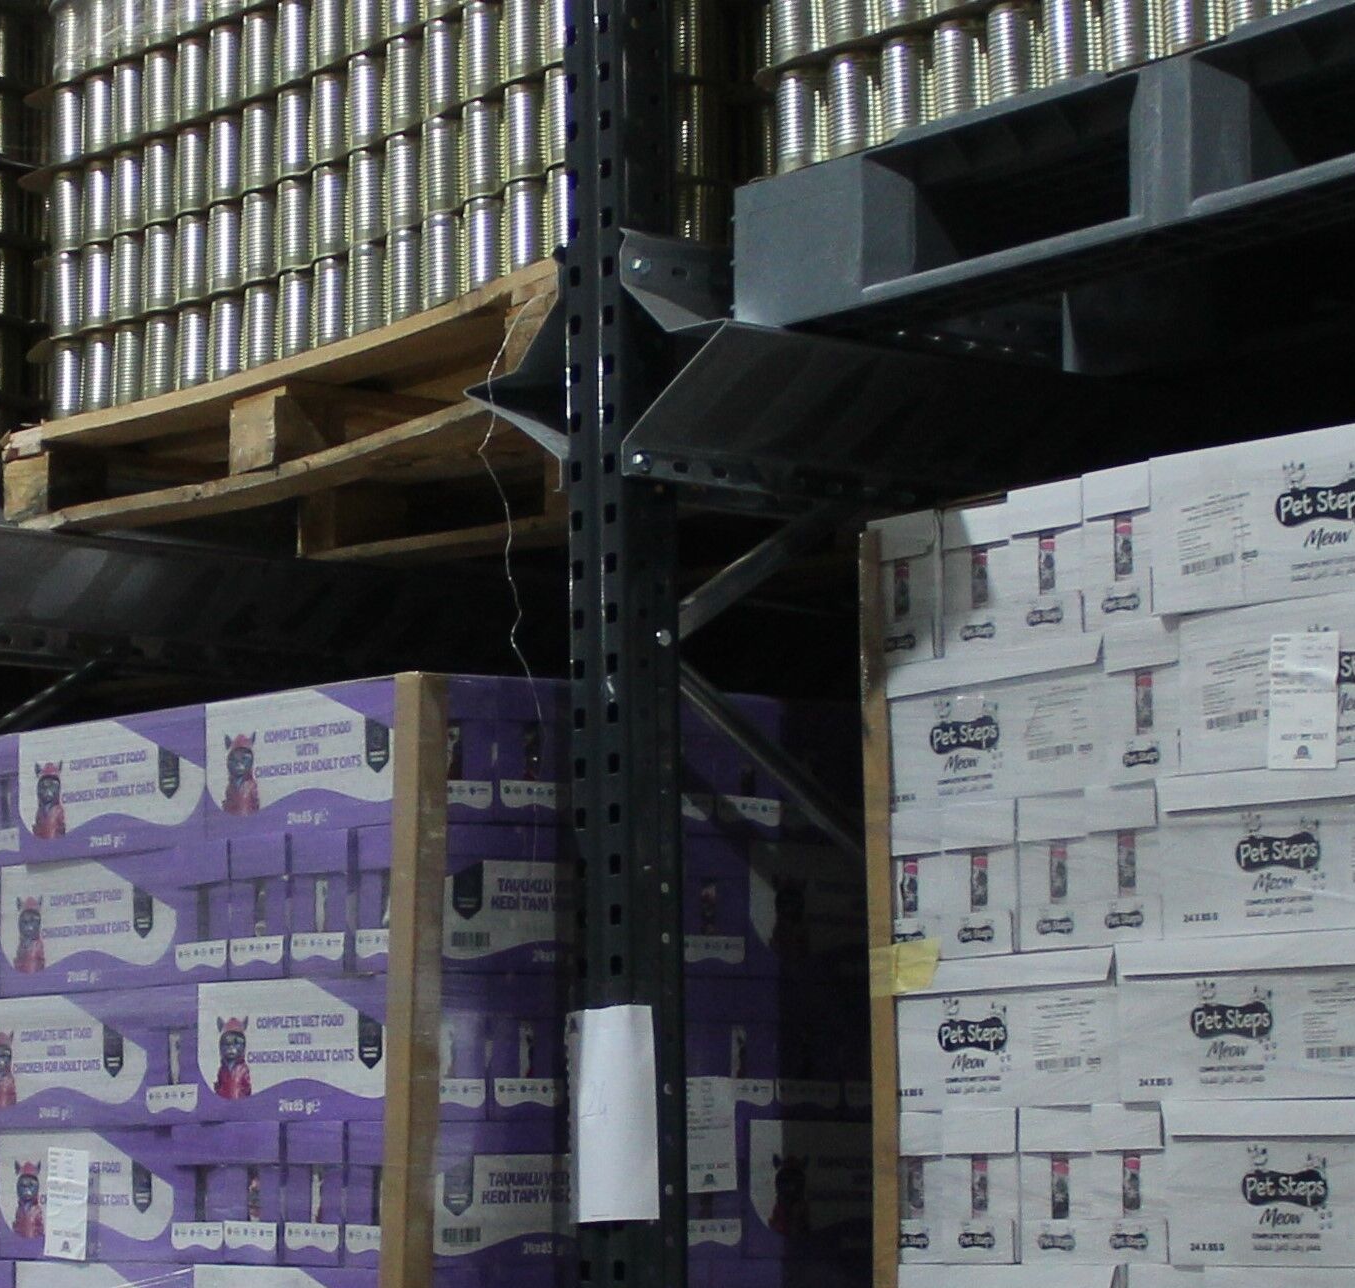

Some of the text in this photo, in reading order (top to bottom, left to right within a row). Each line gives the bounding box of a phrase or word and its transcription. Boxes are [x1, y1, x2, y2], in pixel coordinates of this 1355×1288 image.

[1280, 496, 1312, 521] Pet
[1304, 528, 1351, 549] Meow
[933, 724, 998, 748] Pet Steps
[945, 755, 979, 773] Meow
[1240, 842, 1318, 868] Pet Steps
[1253, 873, 1295, 893] Meow
[1196, 1009, 1270, 1037] Pet Steps
[941, 1025, 1006, 1050] Pet Steps
[1207, 1041, 1248, 1060] Meow
[952, 1054, 987, 1071] Meow
[1247, 1178, 1324, 1204] Pet Steps
[1259, 1208, 1303, 1227] Meow
